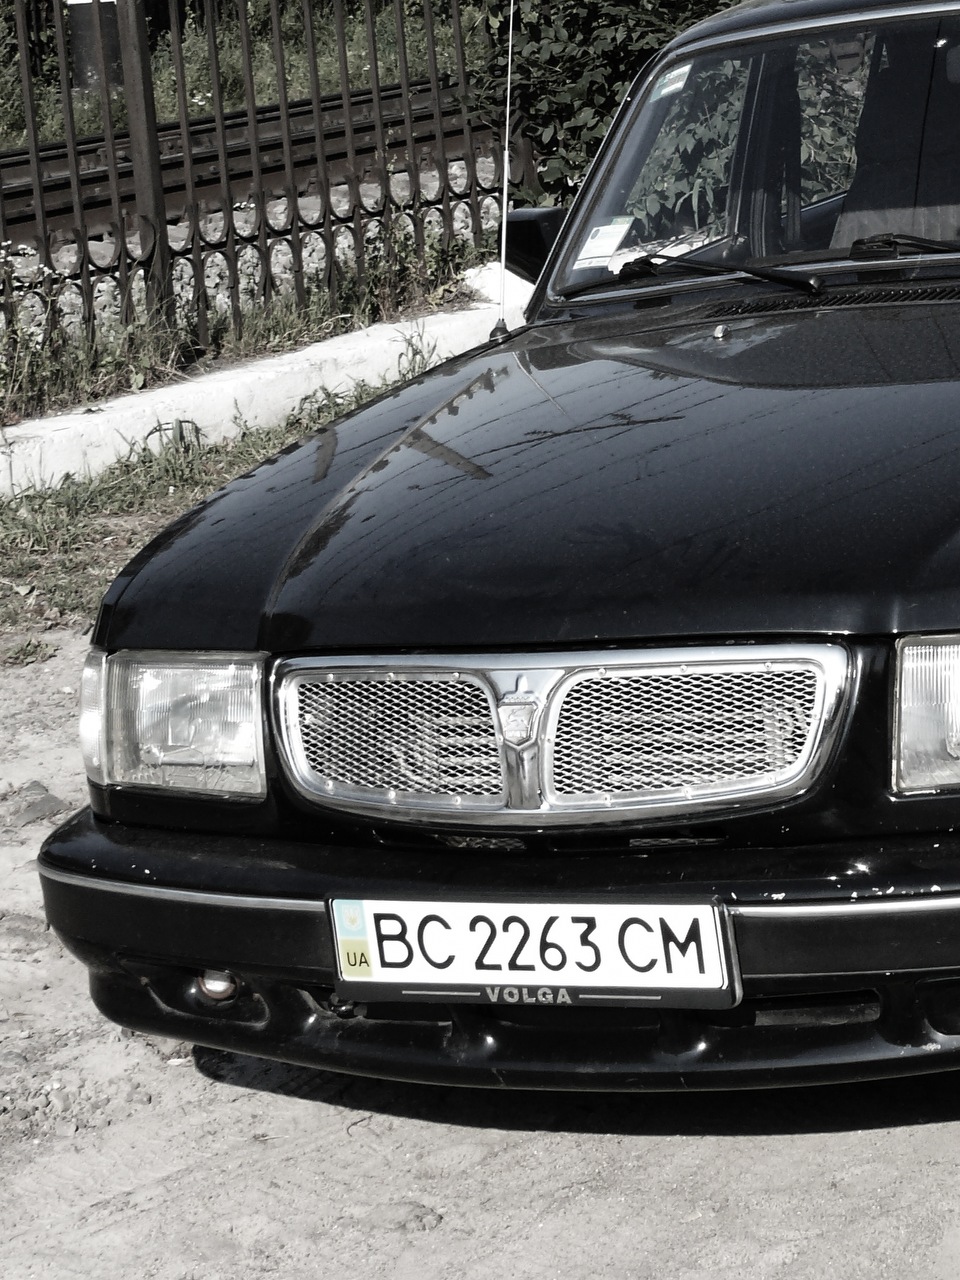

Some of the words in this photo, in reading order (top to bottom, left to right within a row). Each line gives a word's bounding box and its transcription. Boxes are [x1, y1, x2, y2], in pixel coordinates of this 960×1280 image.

[373, 913, 455, 969] BC
[469, 915, 602, 972] 2263
[618, 917, 705, 974] CM
[347, 951, 370, 968] UA
[486, 986, 572, 1004] VOLGA
